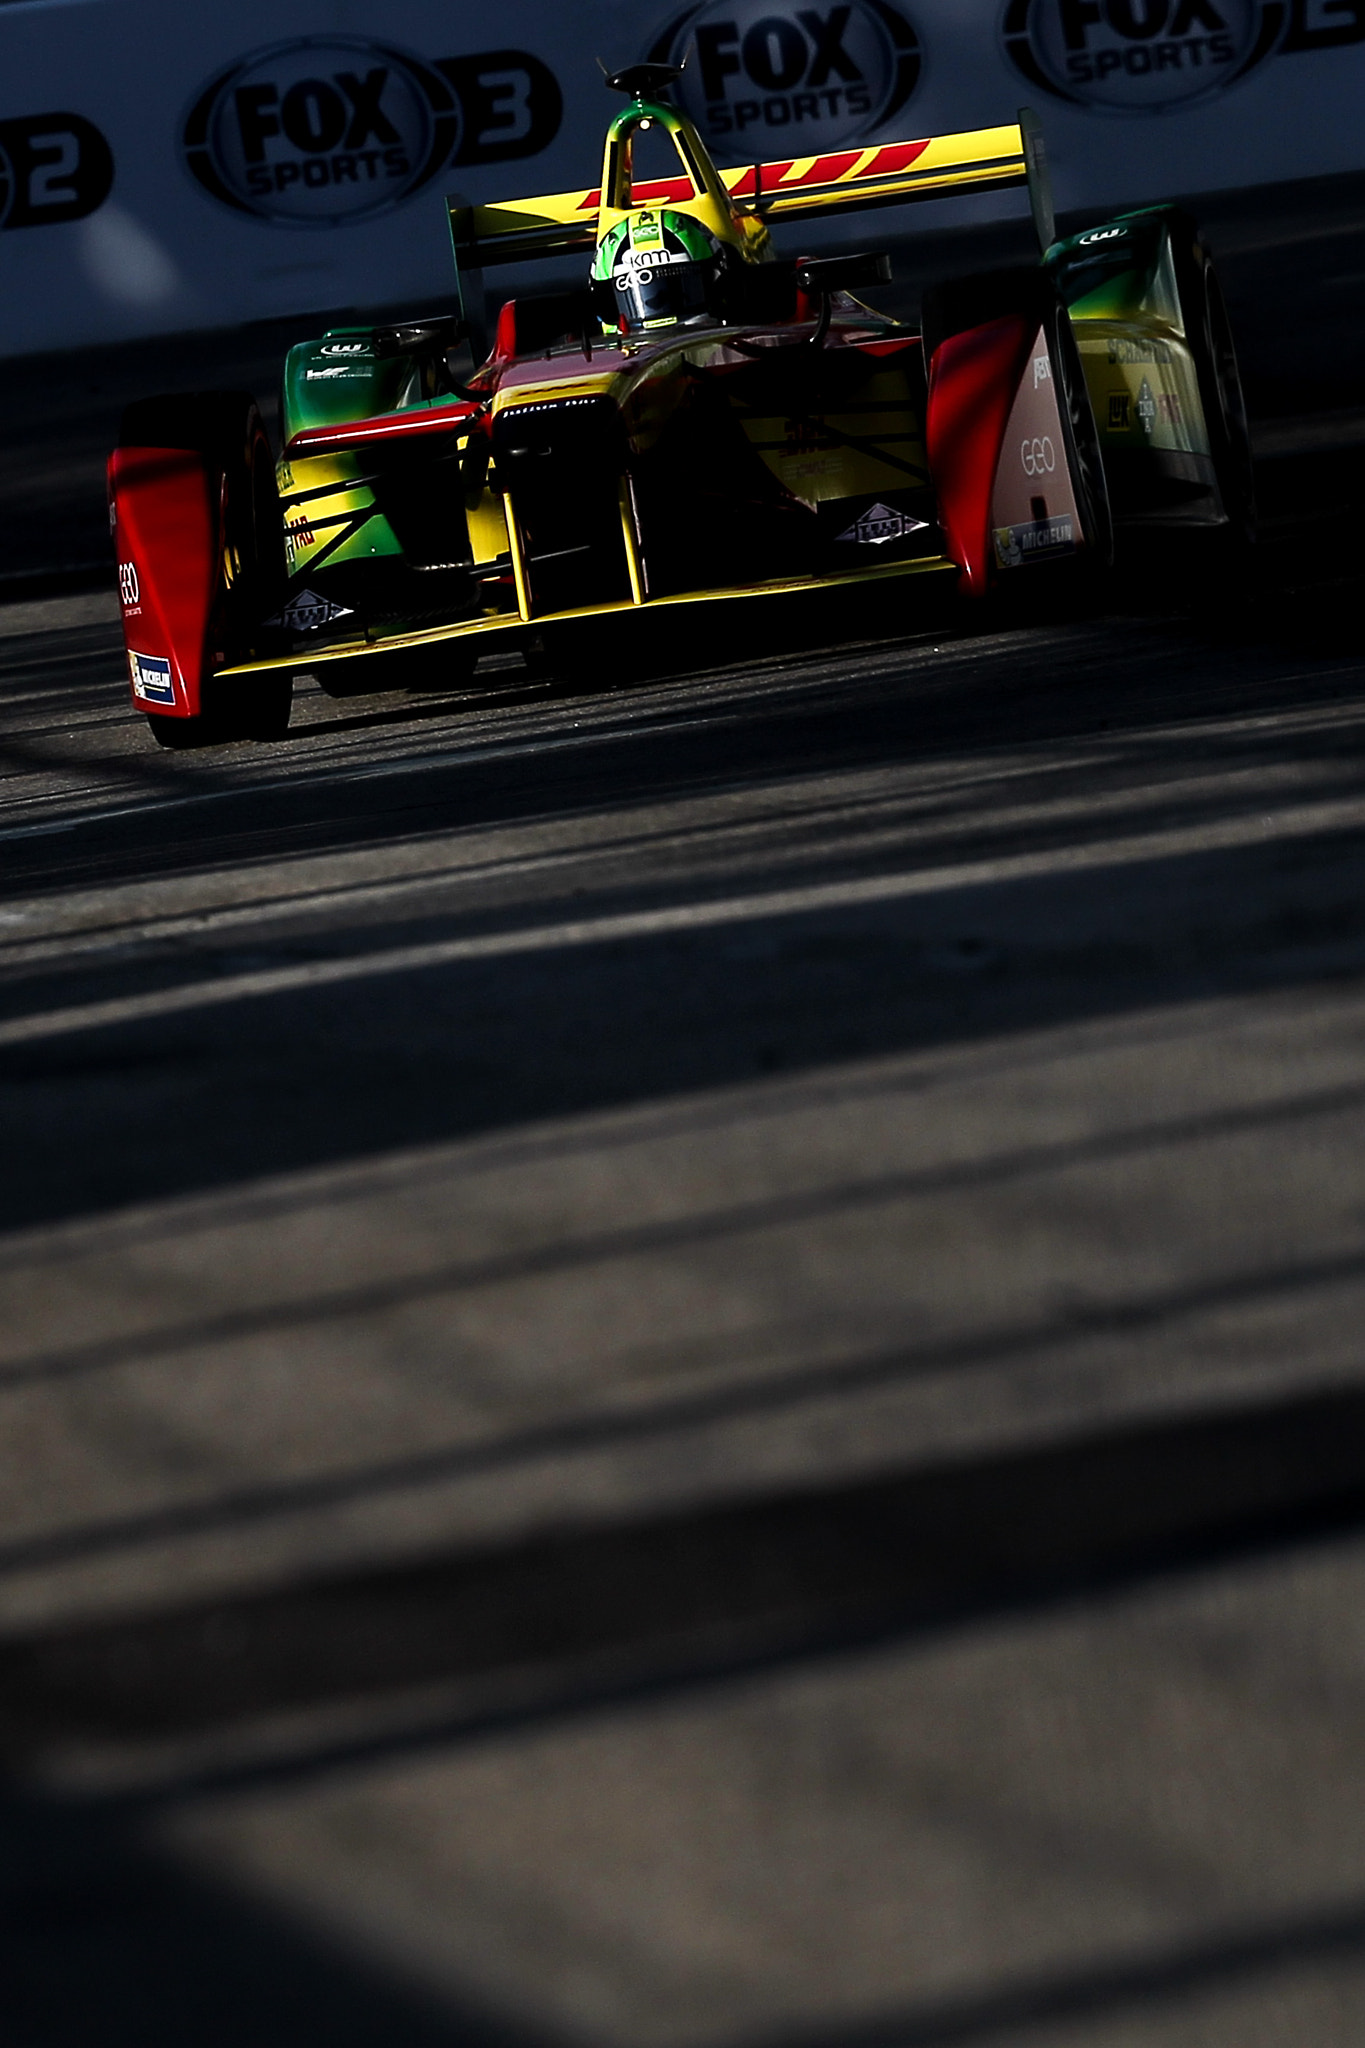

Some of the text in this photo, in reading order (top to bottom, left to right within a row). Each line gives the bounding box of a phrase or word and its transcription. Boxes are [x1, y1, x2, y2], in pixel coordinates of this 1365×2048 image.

[695, 6, 863, 101] FOX
[1064, 35, 1235, 84] SPORTS
[235, 67, 400, 162] FOX
[476, 66, 533, 147] 3
[705, 85, 872, 135] SPORTS
[27, 129, 80, 207] 2
[245, 147, 408, 197] SPORTS
[1021, 436, 1055, 476] GEO
[1022, 525, 1072, 549] MICHELIN
